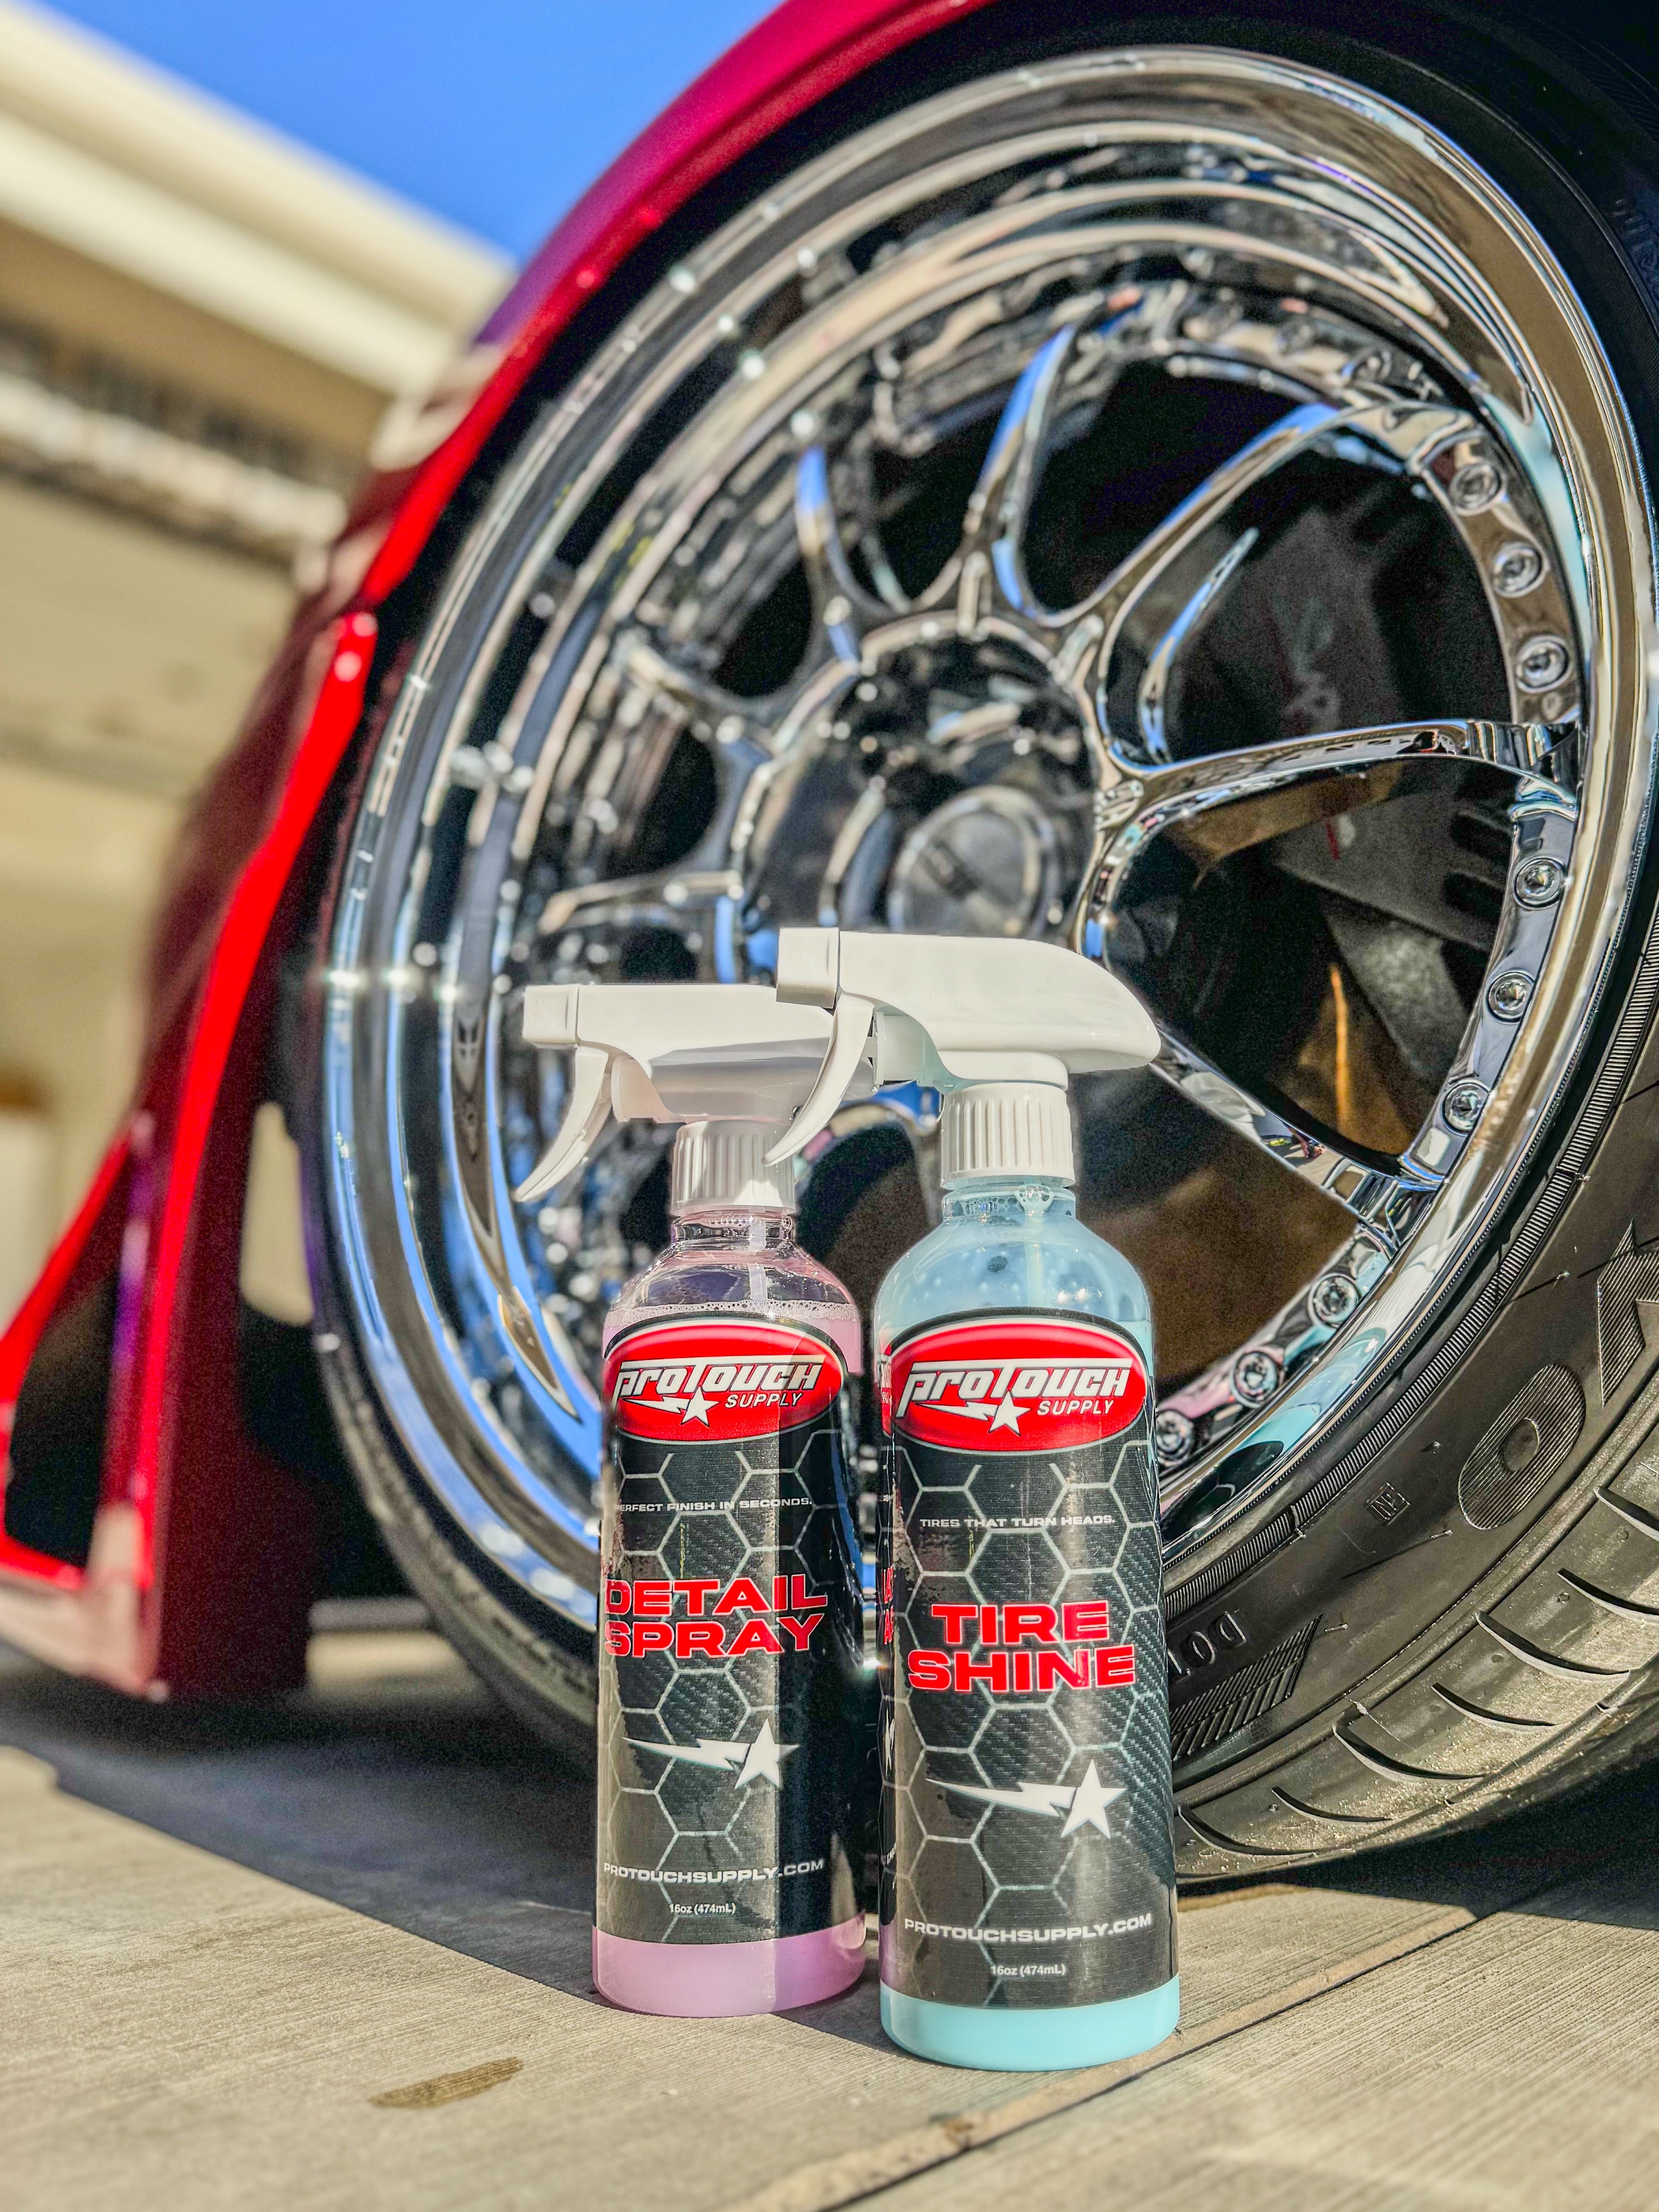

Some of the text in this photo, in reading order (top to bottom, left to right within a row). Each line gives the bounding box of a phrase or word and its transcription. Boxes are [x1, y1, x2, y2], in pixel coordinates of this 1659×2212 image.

[724, 1393, 803, 1409] SUPPLY
[1037, 1399, 1115, 1416] SUPPLY
[666, 1501, 715, 1511] FINISH
[719, 1500, 735, 1509] IN
[738, 1497, 813, 1508] SECONDS.
[920, 1515, 1115, 1527] TIRES THAT TURN HEADS.
[604, 1574, 828, 1617] DETAIL
[931, 1600, 1110, 1644] TIRE
[604, 1613, 825, 1659] SPRAY
[908, 1644, 1136, 1693] SHINE
[603, 1858, 824, 1883] PROTOUCHSUPPLY.COM
[669, 1903, 737, 1915] 16oz (474mL)
[904, 1913, 1152, 1943] PROTOUCHSUPPLY.COM
[991, 1964, 1066, 1977] 16oz (474mL)
